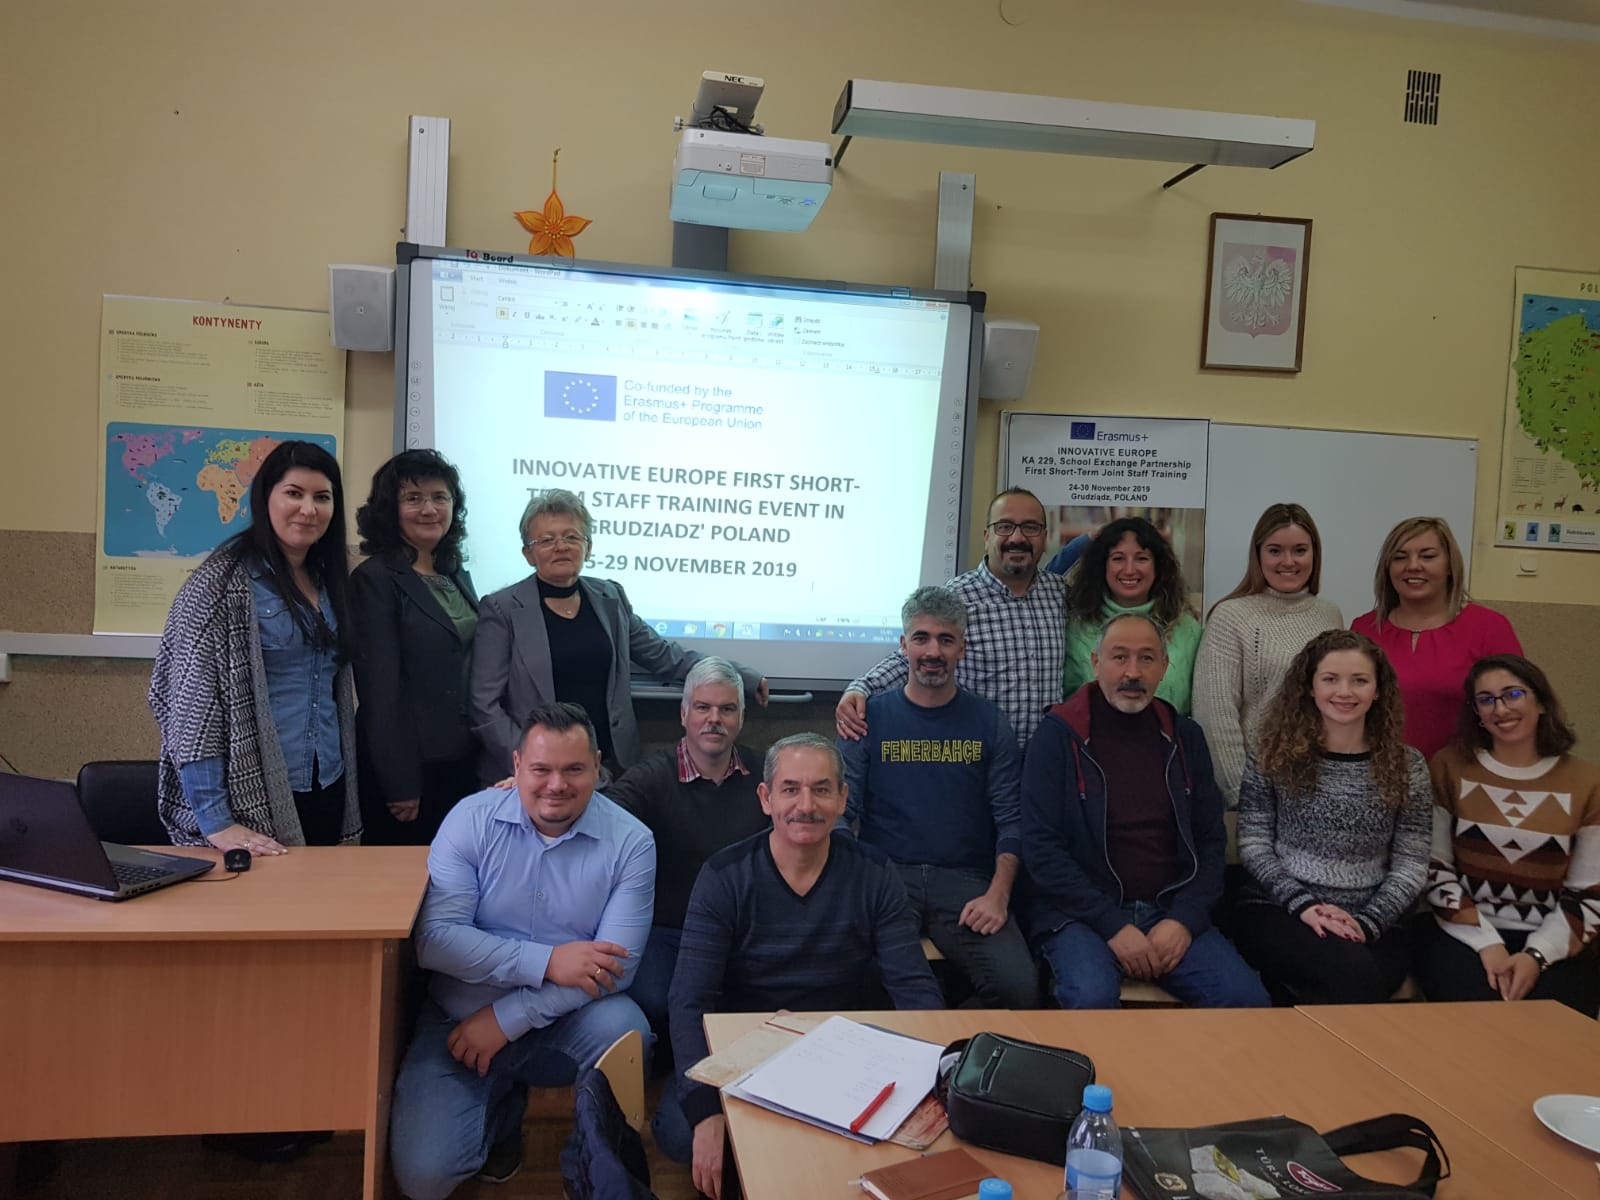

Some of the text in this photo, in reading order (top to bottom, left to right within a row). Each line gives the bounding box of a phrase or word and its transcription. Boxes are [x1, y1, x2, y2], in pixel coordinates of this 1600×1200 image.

[725, 74, 745, 84] NEC
[483, 252, 514, 263] Board
[192, 315, 262, 330] KONTYNENTY
[624, 379, 733, 399] Co-funded by the
[624, 394, 764, 415] Erasmus+ Programme
[623, 410, 763, 430] of the European Union
[1096, 431, 1149, 442] Erasmus+
[1057, 447, 1158, 458] INNOVATIVE EUROPE
[1021, 456, 1192, 470] KA 229, School Exchange Partnership
[512, 458, 861, 493] INNOVATIVE EUROPE FIRST SHORT-
[1025, 466, 1188, 480] First Short-Term Joint Staff Training
[1068, 483, 1151, 493] 24-30 November 2019
[527, 487, 845, 520] TM STAFF TRAINING EVENT IN
[1114, 493, 1148, 502] POLAND
[711, 525, 791, 544] POLAND
[585, 554, 797, 578] 5-29 NOVEMBER 2019
[881, 739, 982, 765] FENERBAHÇE
